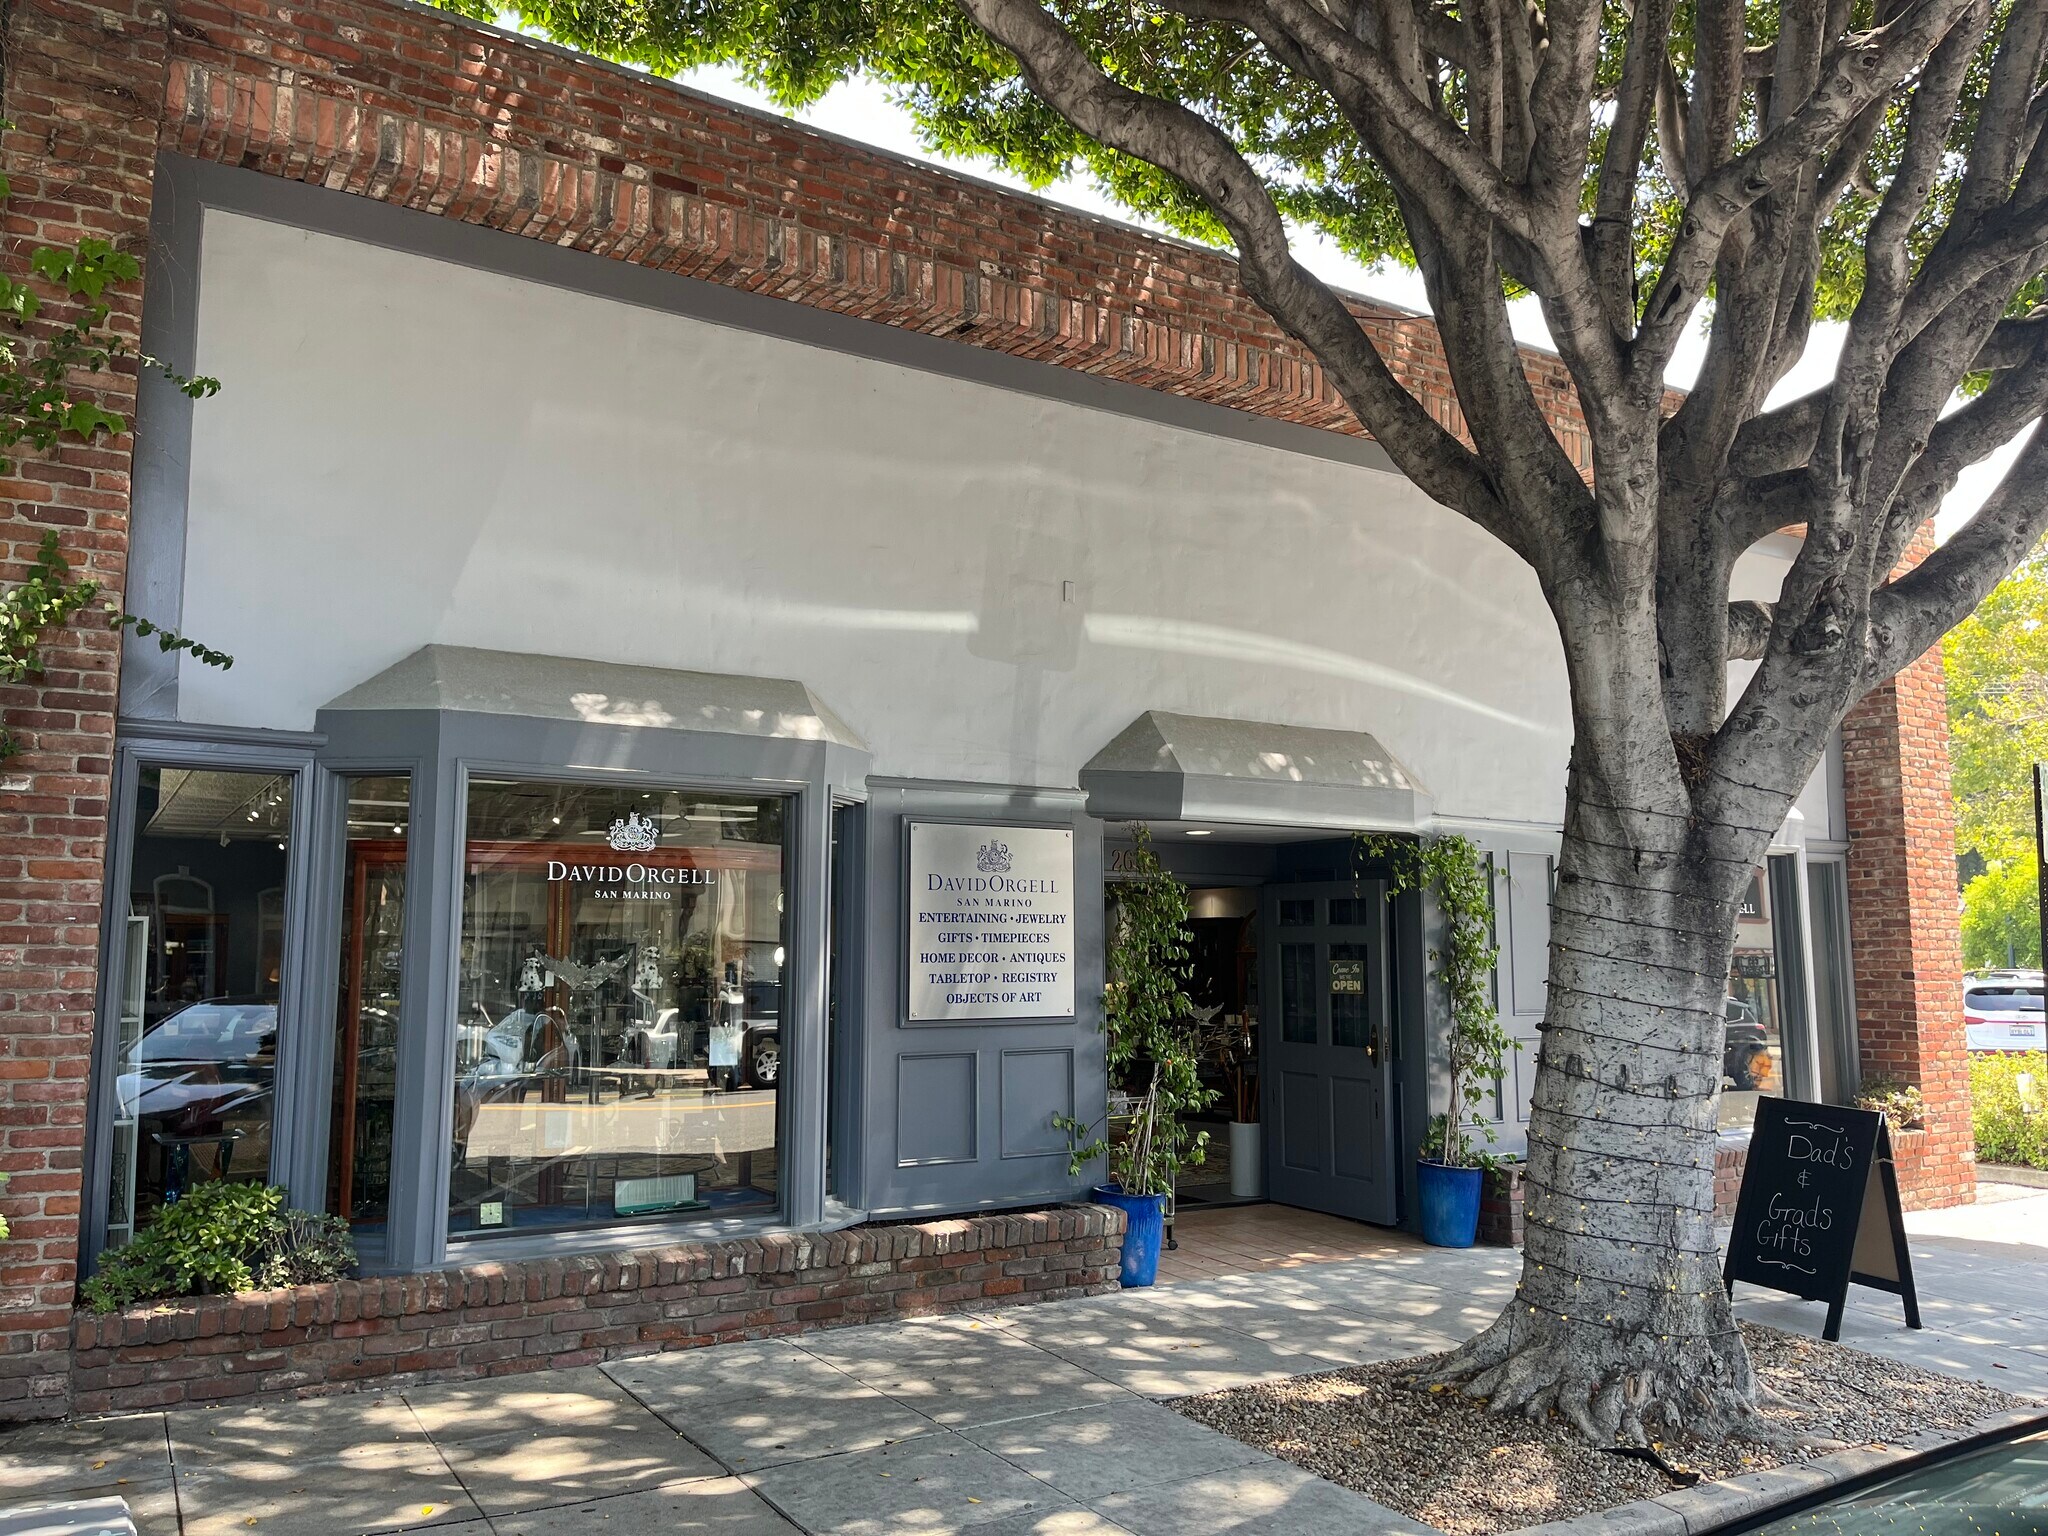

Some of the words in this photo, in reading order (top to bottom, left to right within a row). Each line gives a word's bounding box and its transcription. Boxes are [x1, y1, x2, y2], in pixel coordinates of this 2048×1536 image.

[1111, 849, 1161, 871] 26
[594, 889, 618, 899] SAN
[622, 890, 671, 900] MARINO
[956, 897, 980, 907] SAN
[985, 898, 1033, 908] MARINO
[918, 912, 1008, 924] ENTERTAINING
[1015, 913, 1067, 924] JEWELRY
[937, 932, 973, 943] GIFTS
[981, 932, 1050, 943] TIMEPIECES
[920, 952, 956, 963] HOME
[959, 952, 999, 963] DECOR
[1009, 952, 1066, 965] ANTIQUES
[928, 973, 991, 984] TABLETOP
[1001, 972, 1058, 983] REGISTRY
[1332, 981, 1360, 991] OPEN
[946, 992, 999, 1004] OBJECTS
[1001, 992, 1017, 1003] OF
[1019, 992, 1042, 1002] ART
[1788, 1135, 1853, 1169] Dad's
[1768, 1192, 1833, 1230] Grads
[1756, 1219, 1811, 1256] Gifts
